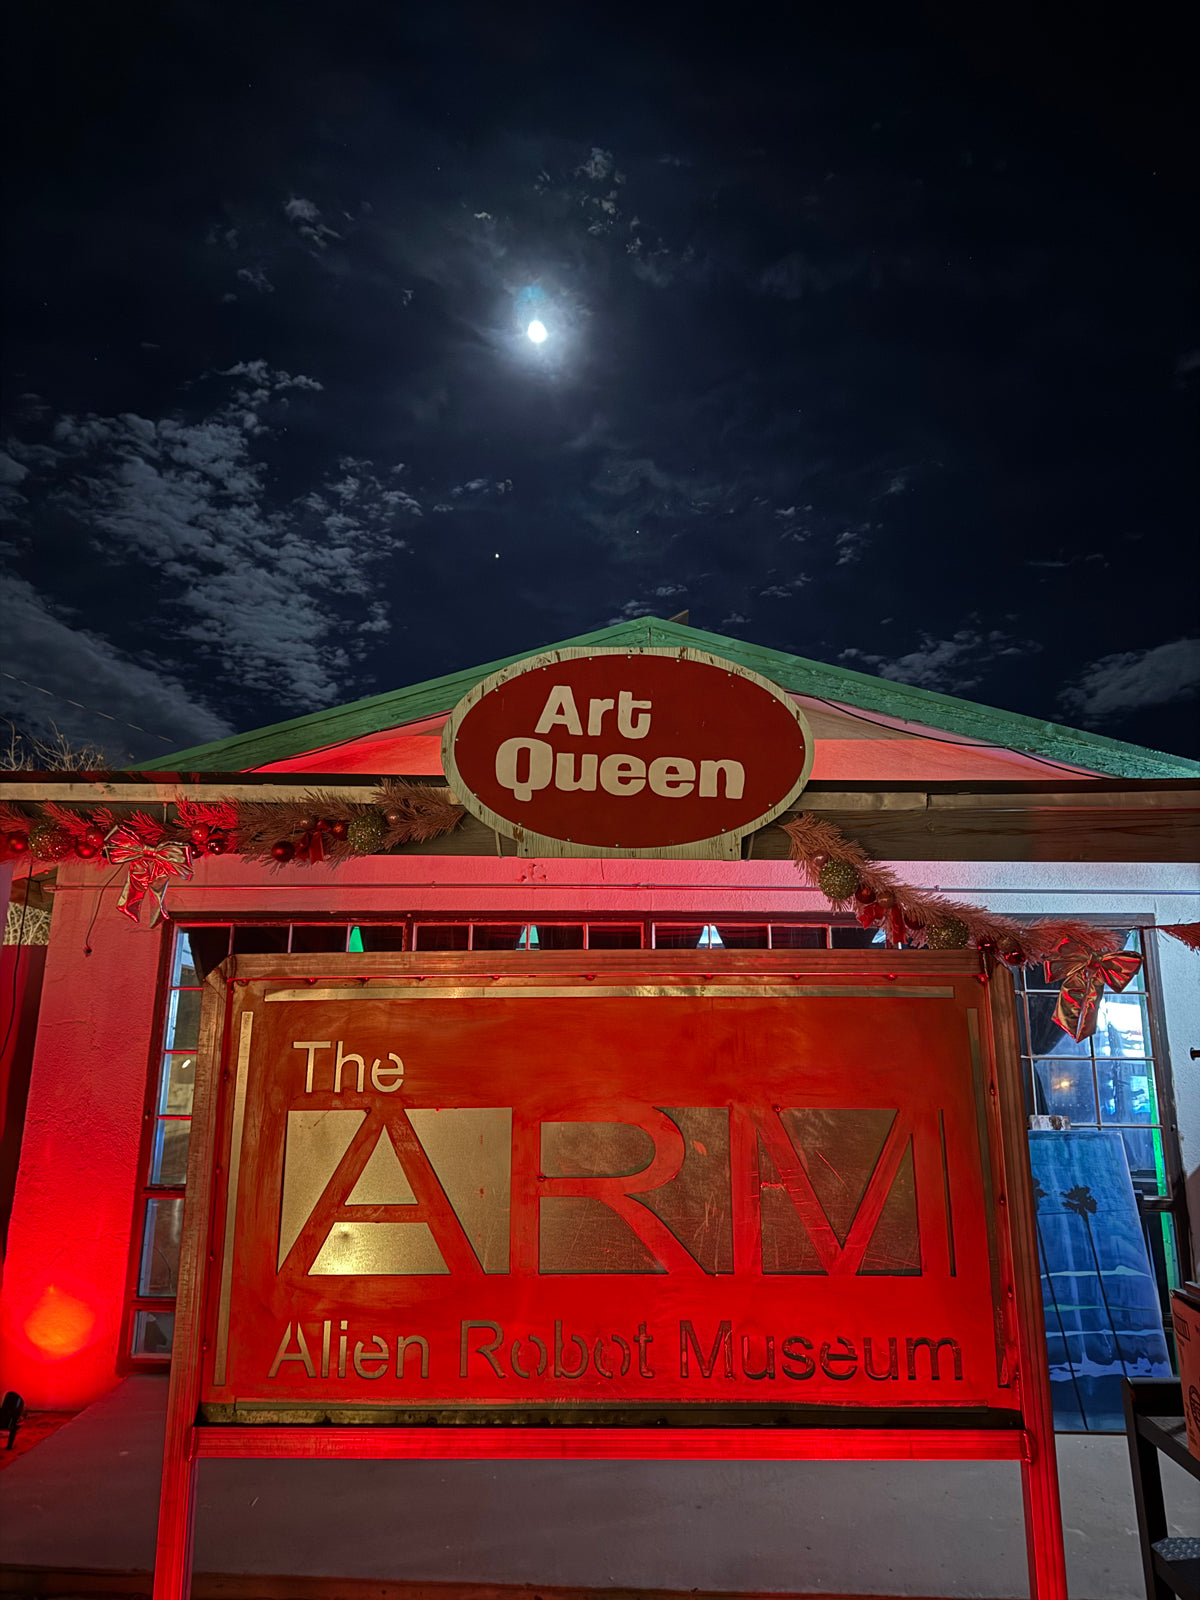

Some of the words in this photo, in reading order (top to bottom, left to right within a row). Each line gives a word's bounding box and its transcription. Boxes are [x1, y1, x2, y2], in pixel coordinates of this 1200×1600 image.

[534, 685, 652, 739] Art
[495, 737, 746, 801] Queen
[293, 1040, 405, 1093] The
[276, 1107, 951, 1277] ARM
[267, 1320, 430, 1379] Alien
[459, 1319, 654, 1379] Robot
[679, 1320, 964, 1381] Museum
